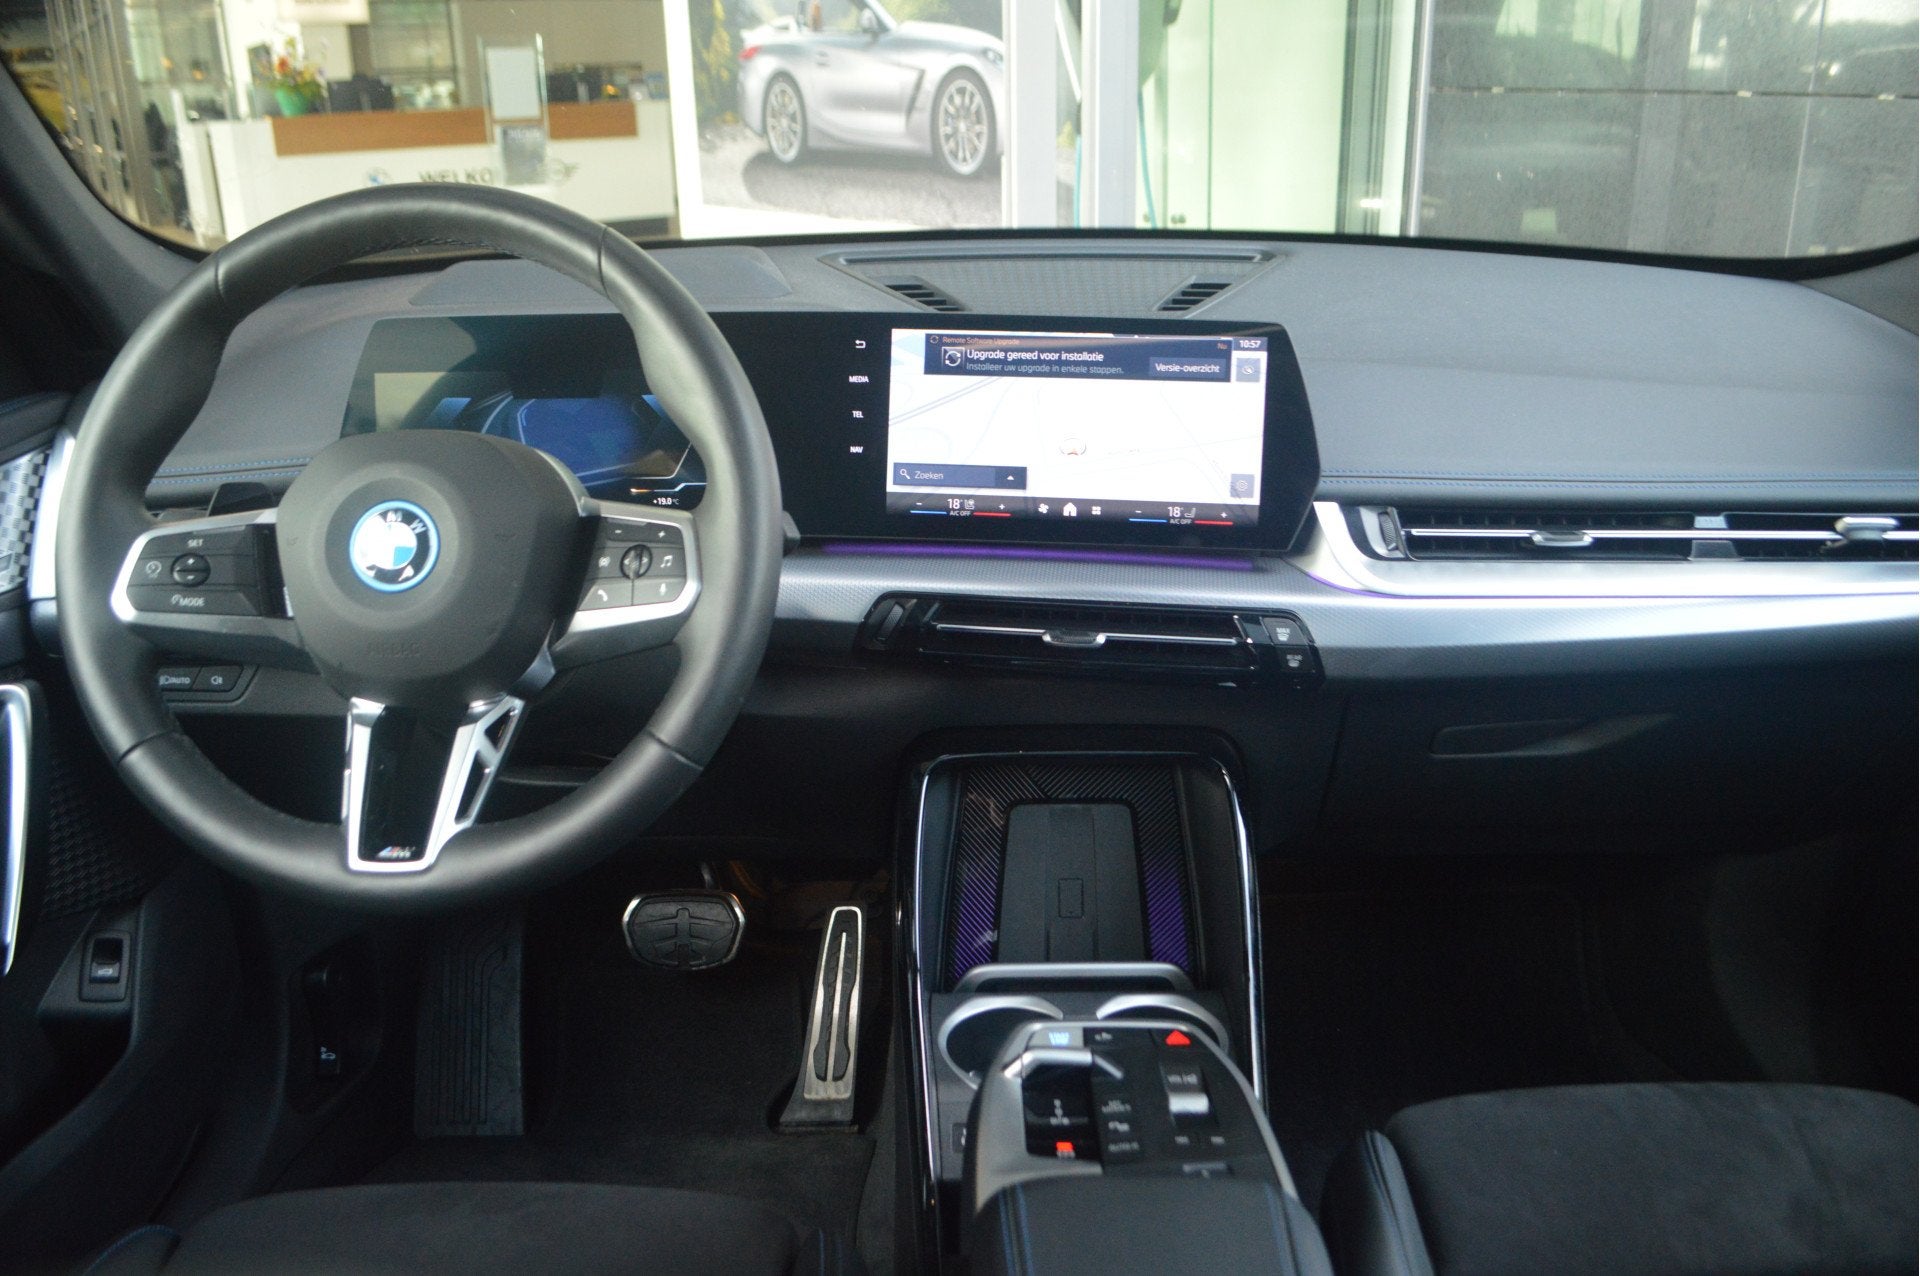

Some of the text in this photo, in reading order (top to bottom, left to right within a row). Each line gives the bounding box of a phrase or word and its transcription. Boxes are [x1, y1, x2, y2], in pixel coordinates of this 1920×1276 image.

[418, 167, 494, 184] WELKO
[1239, 340, 1262, 349] 10:57
[966, 349, 1104, 362] Upgrade gereed voor installatie
[966, 362, 1002, 371] Installeer
[1017, 363, 1051, 373] upgrade
[1052, 364, 1060, 372] in
[1061, 364, 1087, 373] enkele
[1089, 366, 1124, 375] stappen.
[1155, 362, 1220, 373] Versie-overzicht
[848, 375, 870, 383] MEDIA
[852, 410, 864, 418] TEL
[849, 446, 864, 454] NAV
[914, 470, 944, 480] Zoeken
